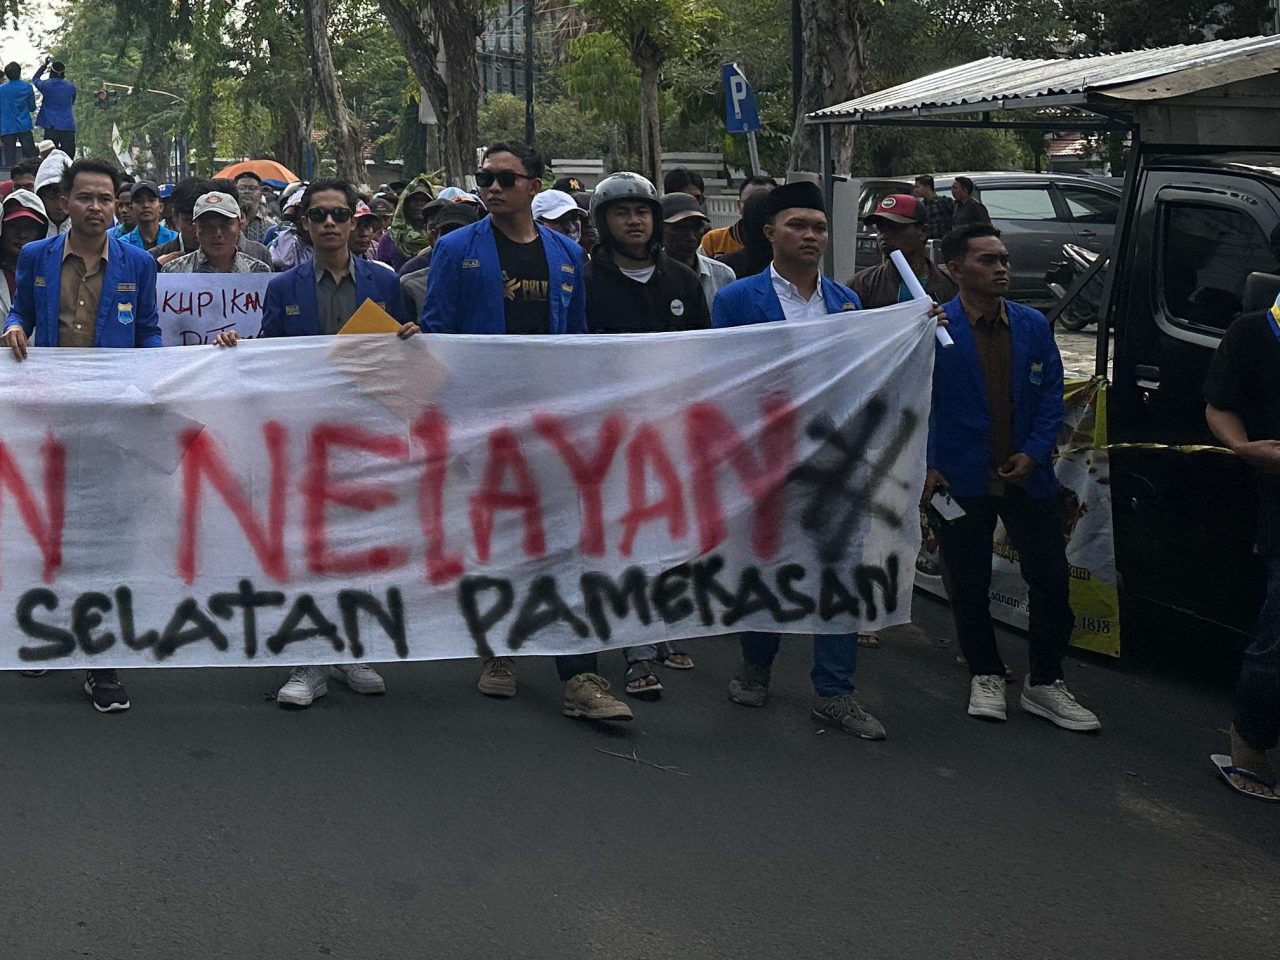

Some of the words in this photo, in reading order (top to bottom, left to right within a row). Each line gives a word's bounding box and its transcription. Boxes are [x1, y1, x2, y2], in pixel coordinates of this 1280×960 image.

[729, 75, 747, 119] P
[175, 391, 799, 585] NELAYAN
[17, 577, 410, 662] SELATAN
[457, 551, 901, 659] PAMEKASAN
[1081, 618, 1112, 635] 1818
